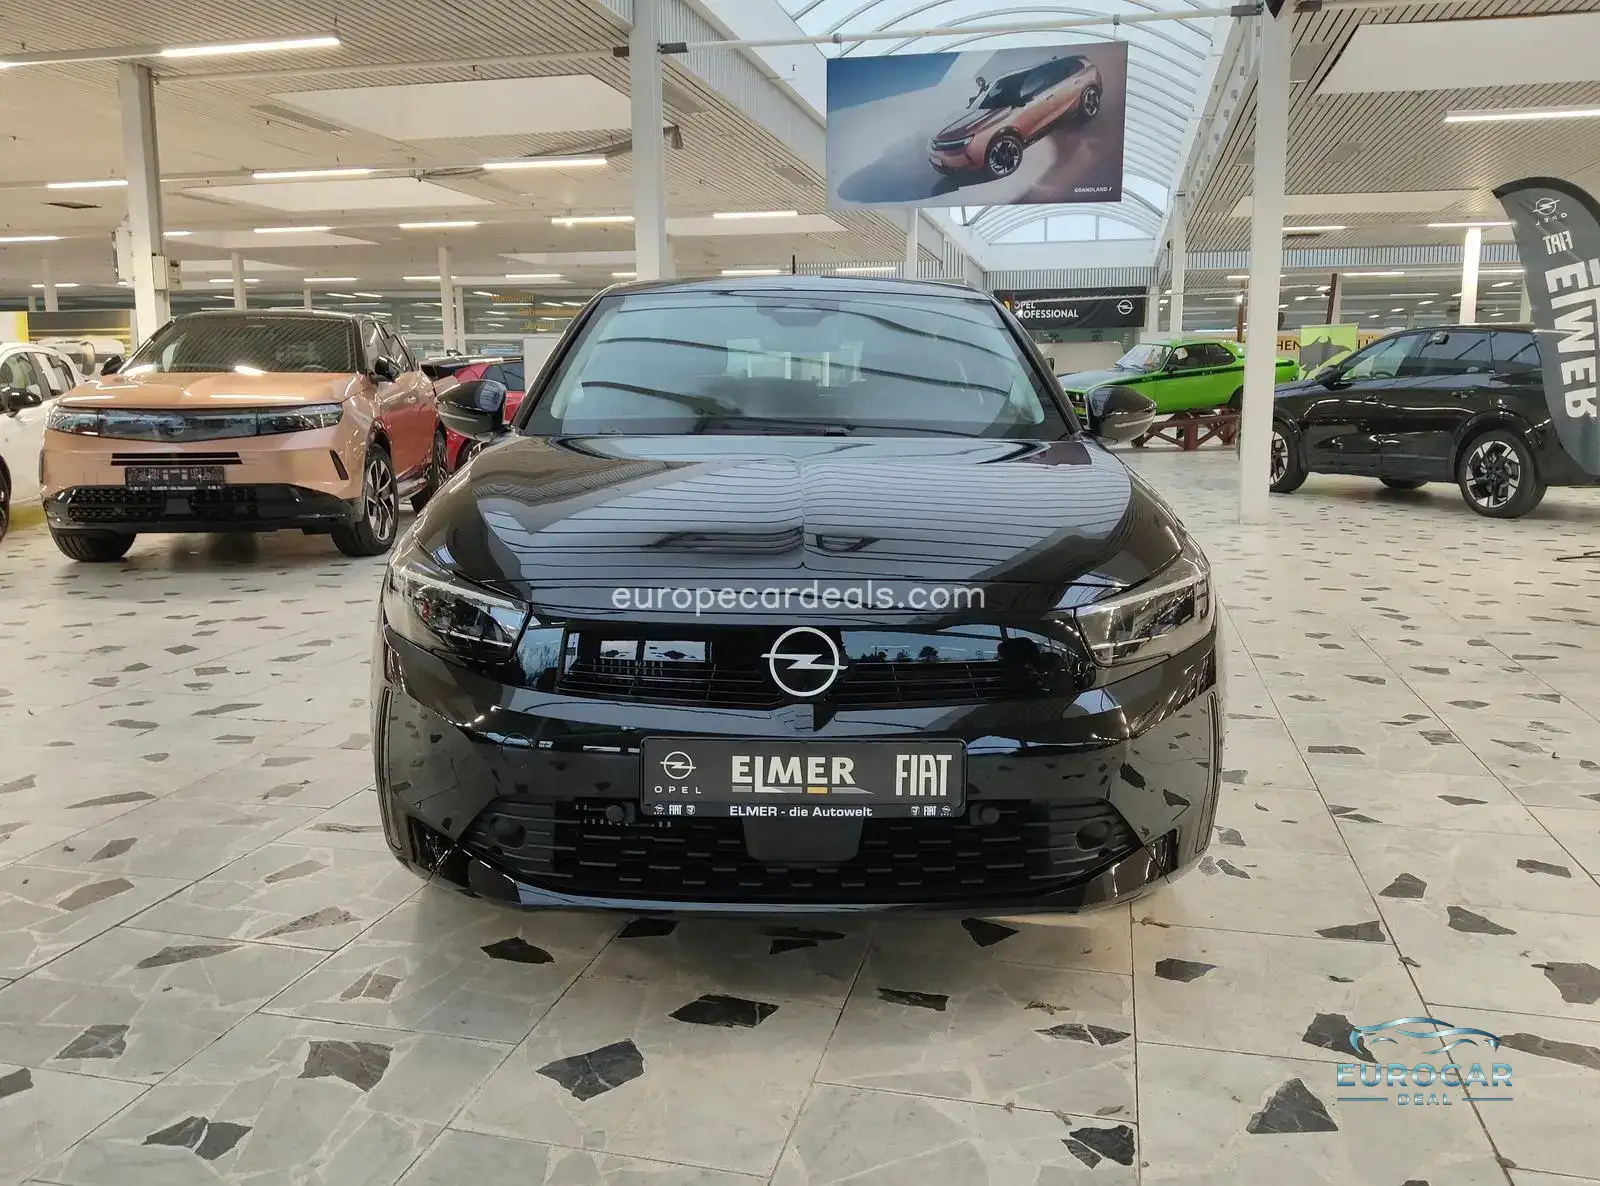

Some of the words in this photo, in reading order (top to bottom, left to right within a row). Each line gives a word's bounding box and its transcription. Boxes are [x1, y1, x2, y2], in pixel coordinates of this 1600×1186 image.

[1014, 301, 1036, 309] OPEL
[1015, 309, 1079, 319] ROFESSIONAL
[731, 755, 856, 793] ELMER
[895, 754, 953, 796] FIAT
[654, 785, 702, 794] OPEL
[668, 804, 683, 815] FIAT
[729, 805, 778, 817] ELMER
[789, 805, 809, 817] die
[812, 806, 873, 817] Autowelt
[923, 805, 937, 816] FIAT
